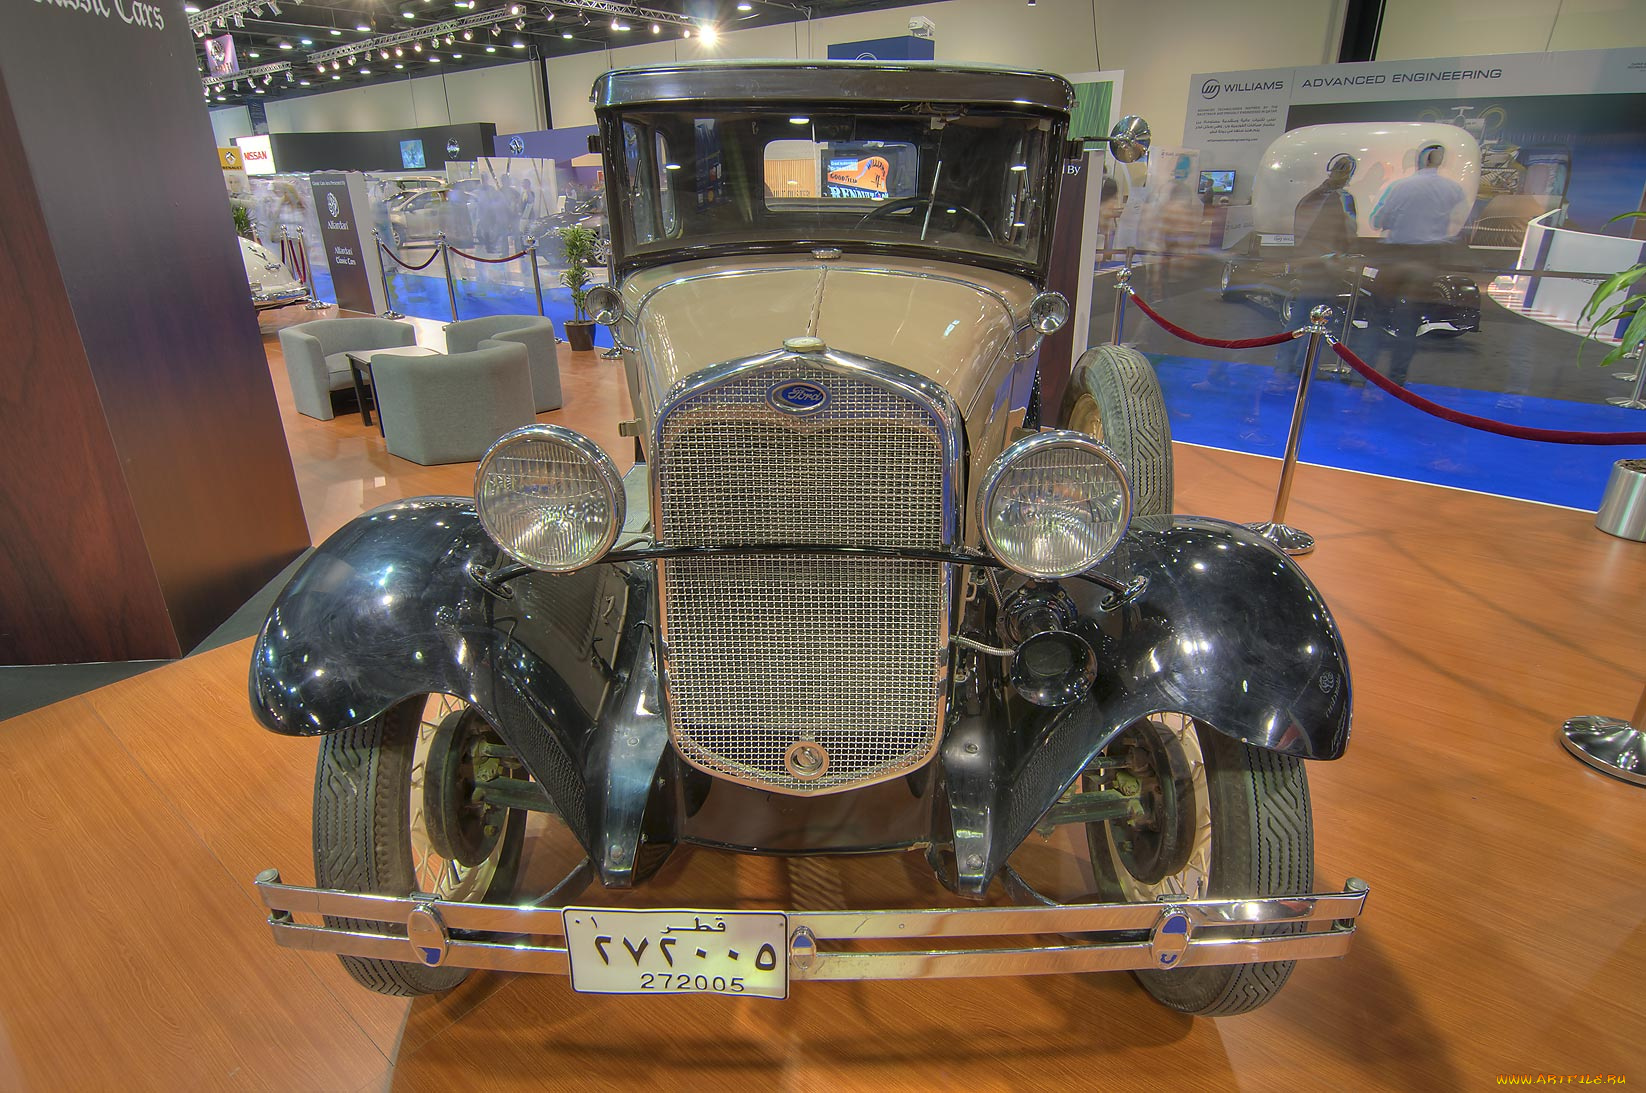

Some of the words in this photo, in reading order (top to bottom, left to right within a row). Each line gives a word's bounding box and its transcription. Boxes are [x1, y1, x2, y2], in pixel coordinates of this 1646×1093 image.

[114, 0, 165, 31] Cars
[1223, 81, 1284, 93] WILLIAMS
[1301, 75, 1386, 89] ADVANCED
[1391, 69, 1503, 84] ENGINEERING
[243, 150, 267, 161] NISSAN
[1067, 165, 1081, 176] By
[788, 386, 823, 401] Ford
[660, 916, 727, 935] قطر
[594, 935, 777, 972] ٢٧٢٠٠٥
[640, 973, 745, 993] 272005
